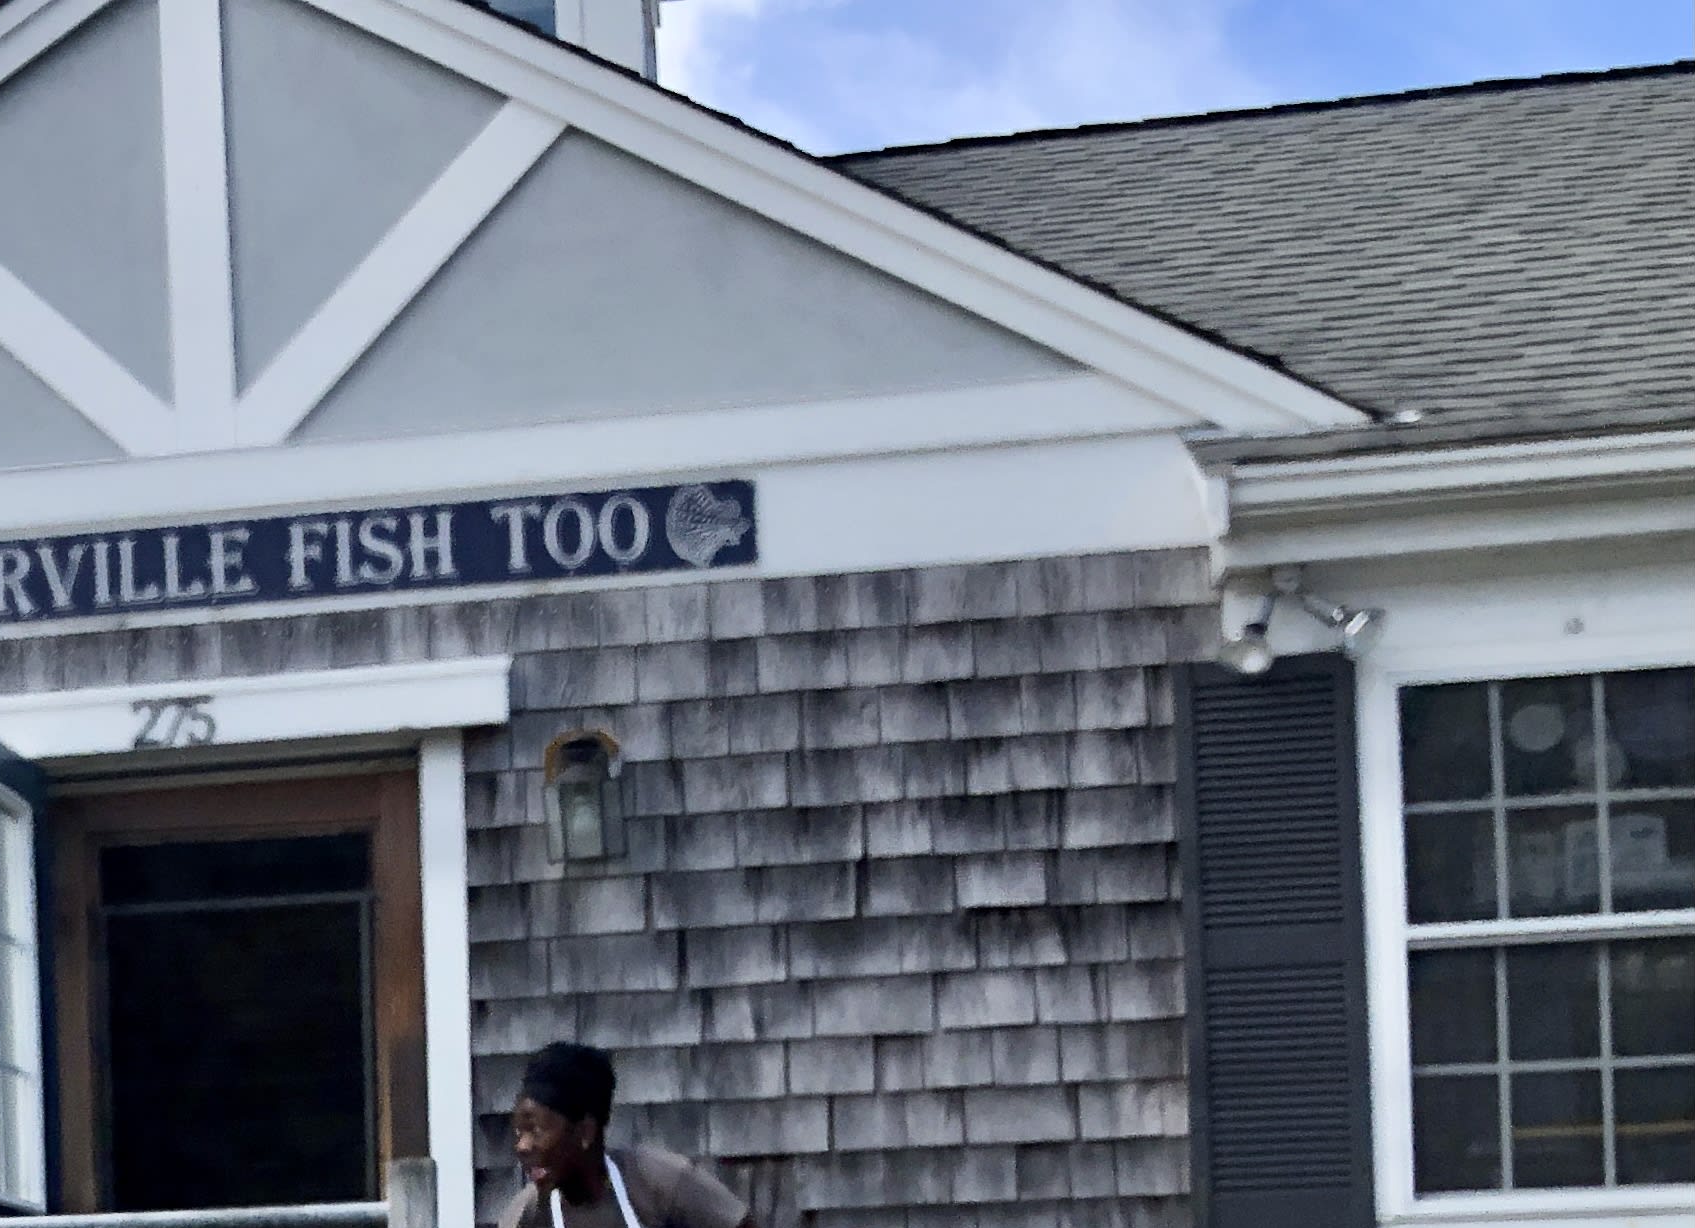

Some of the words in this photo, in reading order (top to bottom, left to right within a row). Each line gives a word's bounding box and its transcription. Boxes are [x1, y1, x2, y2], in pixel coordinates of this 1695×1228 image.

[286, 510, 454, 591] FISH
[491, 496, 652, 573] TOO
[129, 694, 218, 748] 275
